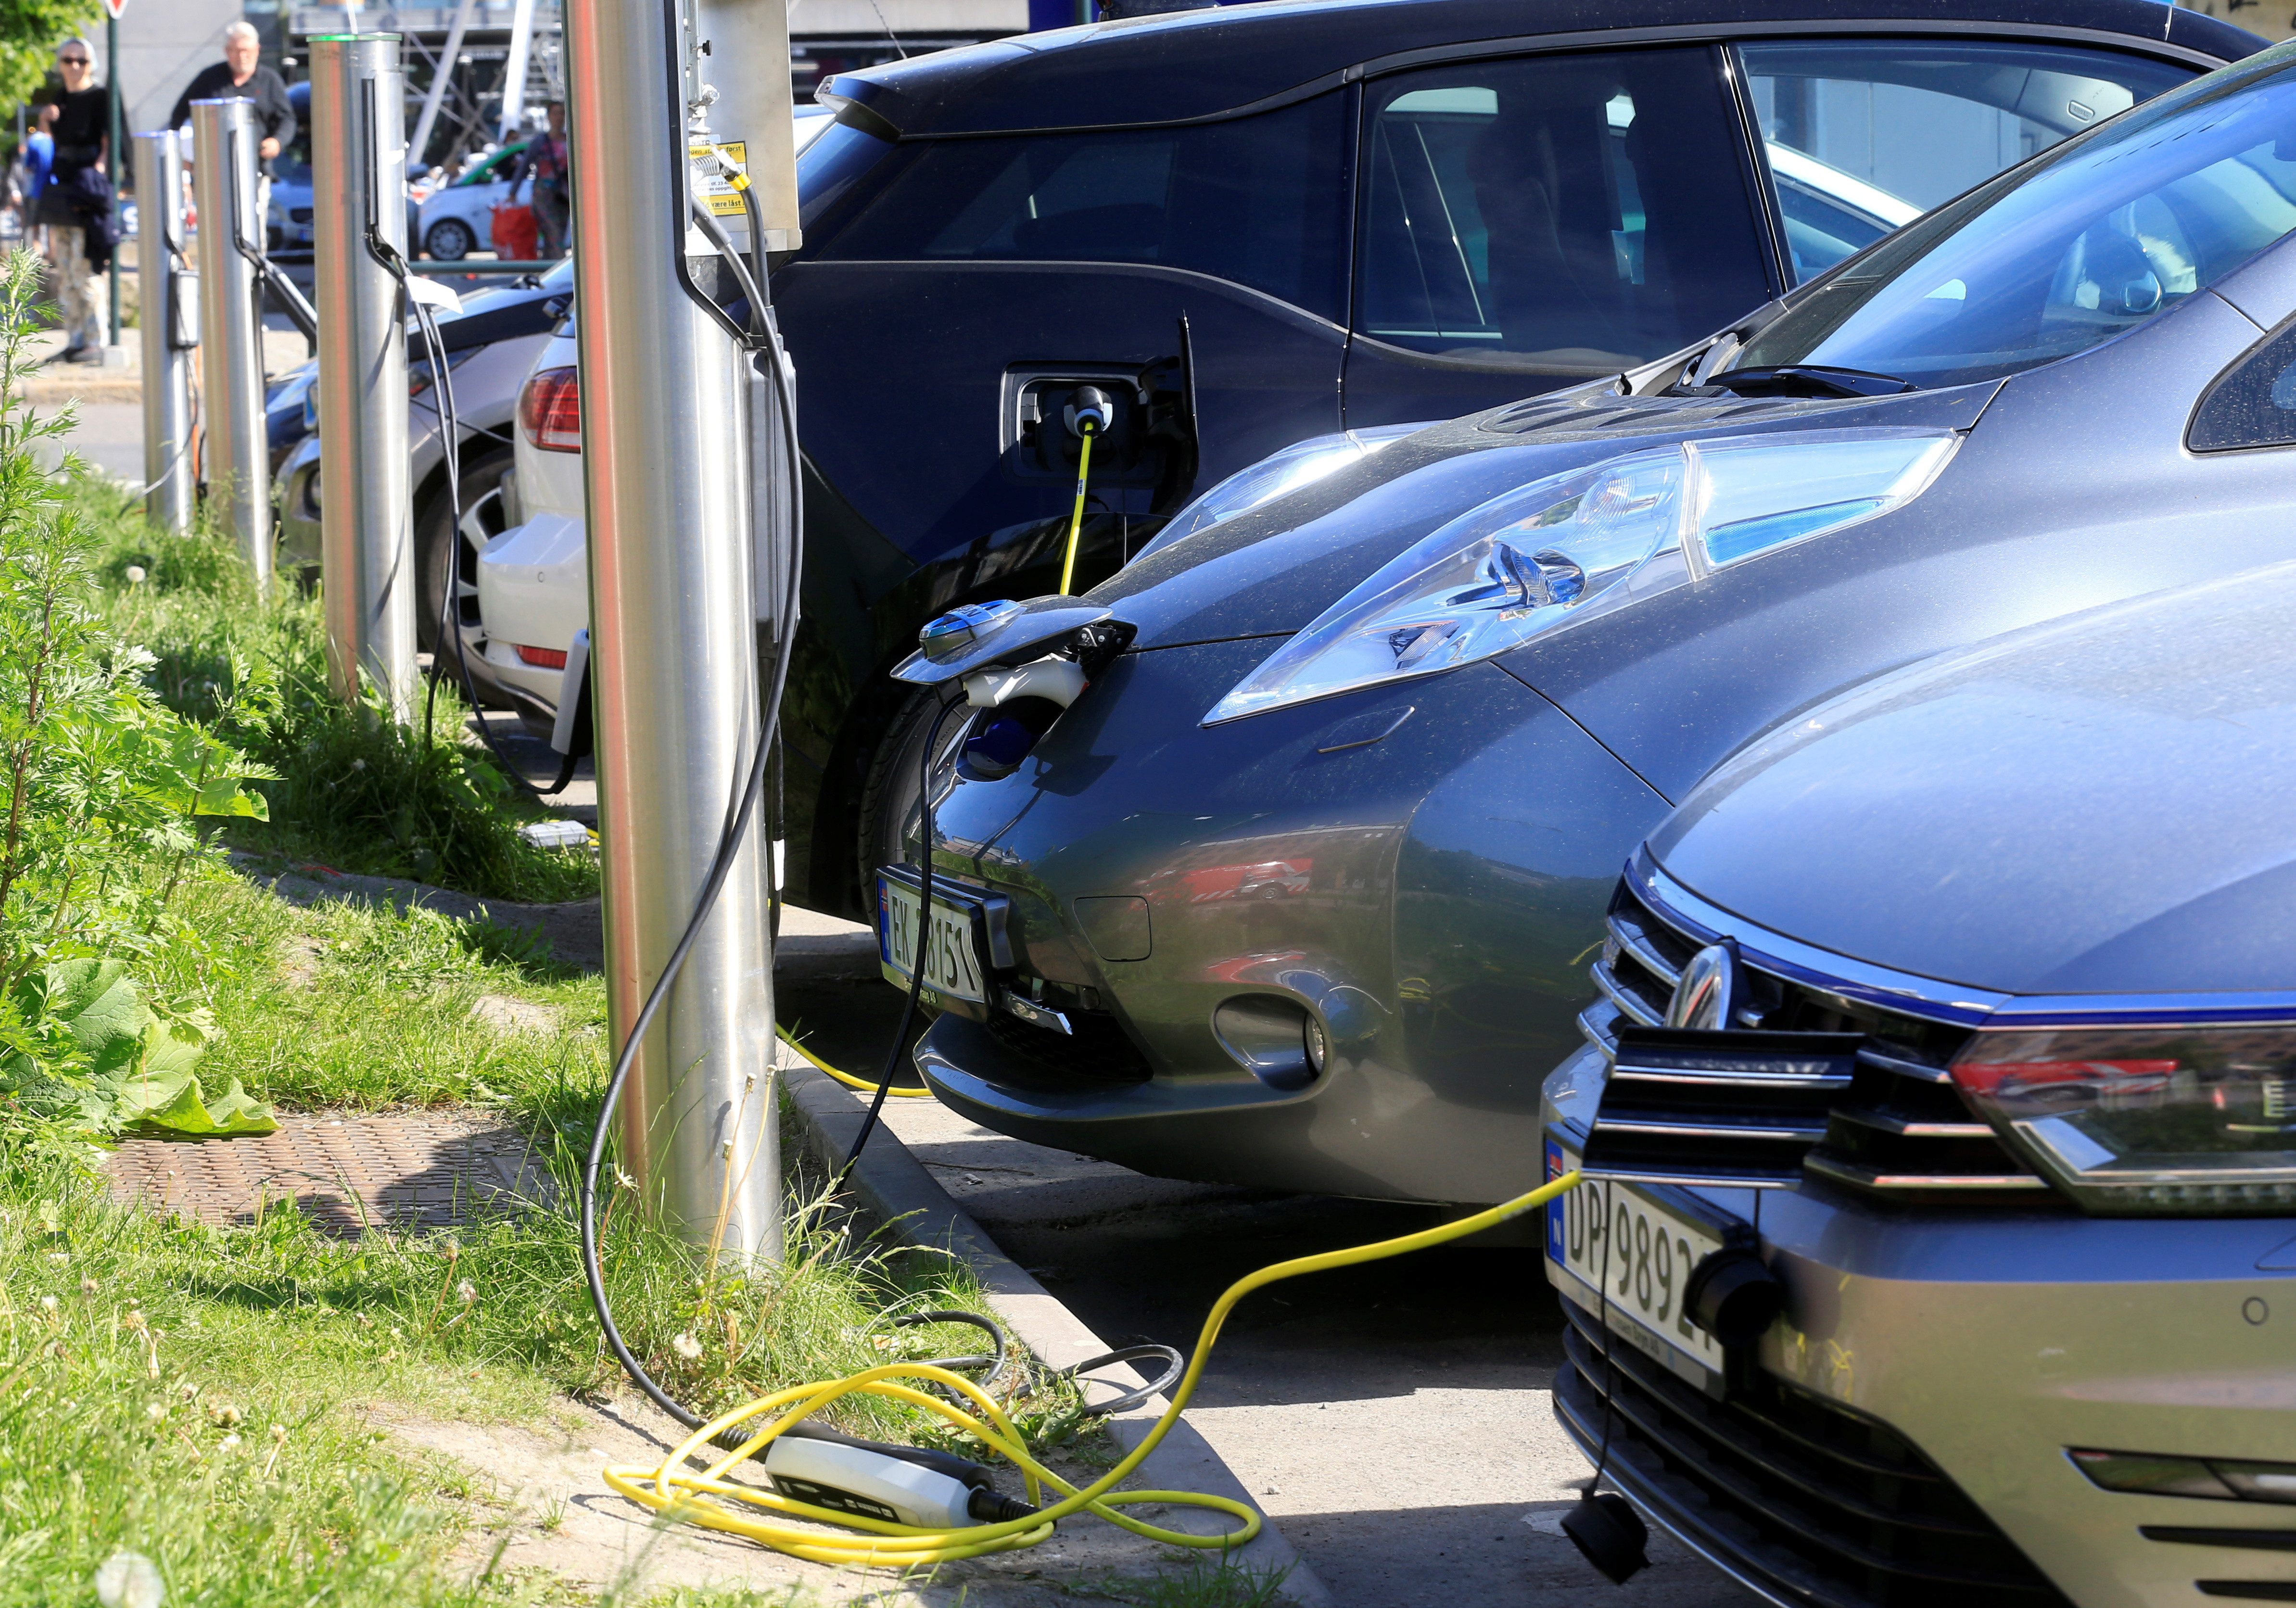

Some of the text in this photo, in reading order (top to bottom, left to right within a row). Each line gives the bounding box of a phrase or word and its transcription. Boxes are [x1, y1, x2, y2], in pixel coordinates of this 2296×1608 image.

[892, 894, 977, 991] EK 8151
[1570, 1170, 1603, 1274] DP
